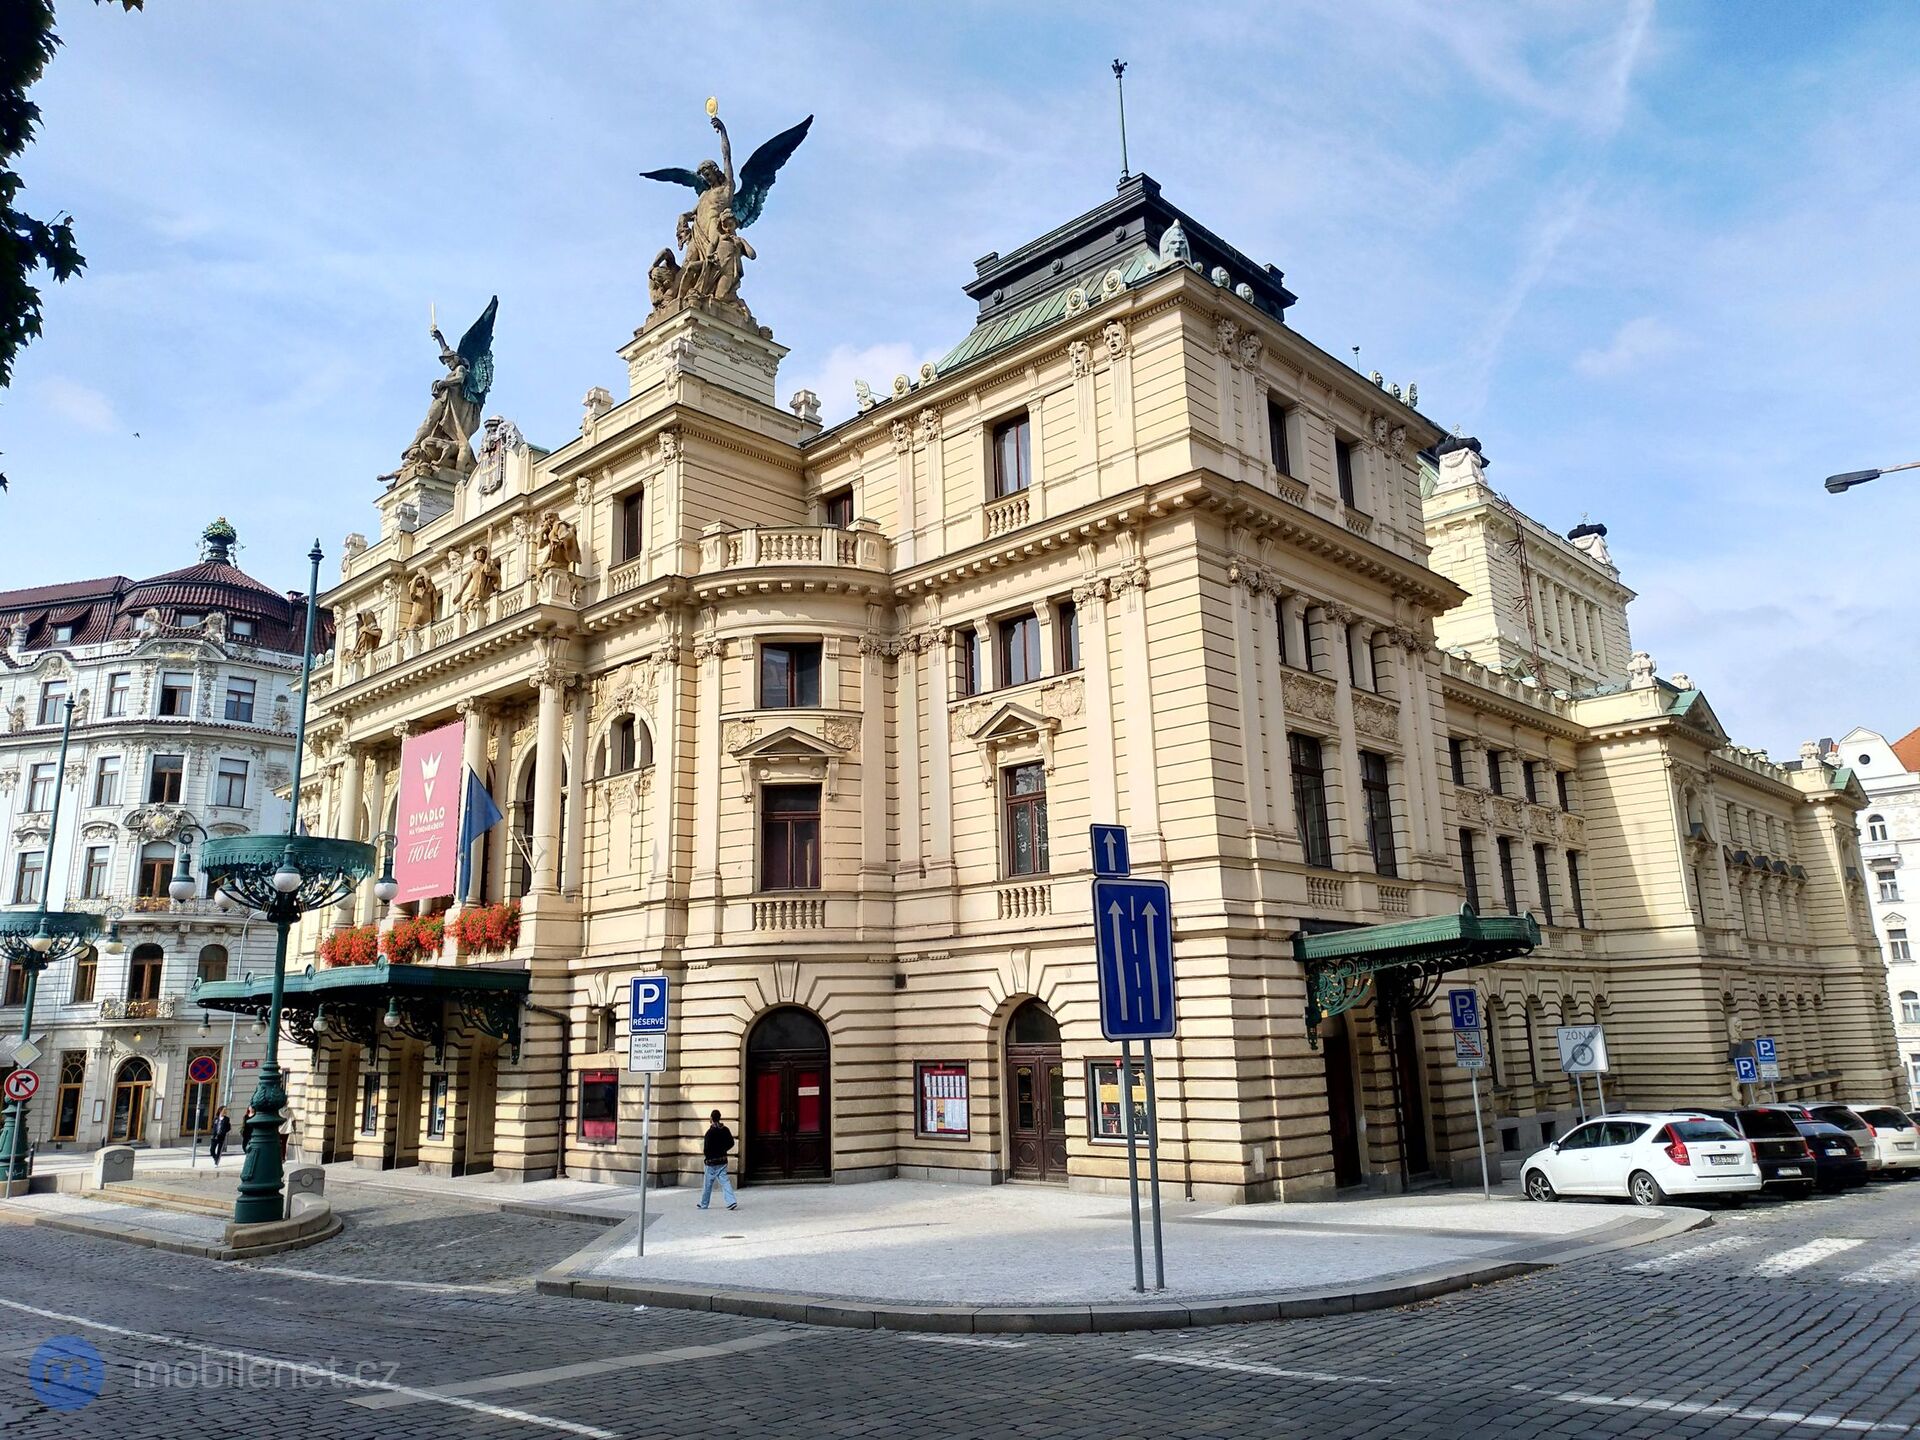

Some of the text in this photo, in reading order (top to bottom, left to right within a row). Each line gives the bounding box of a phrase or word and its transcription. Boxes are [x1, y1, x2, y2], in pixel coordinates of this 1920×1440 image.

[409, 806, 445, 827] DIVADLO
[407, 835, 441, 864] 110 let
[638, 983, 660, 1015] P
[1455, 995, 1471, 1017] P
[633, 1017, 664, 1026] RÉSERVÉ
[1759, 1041, 1770, 1056] P
[1739, 1061, 1751, 1075] P
